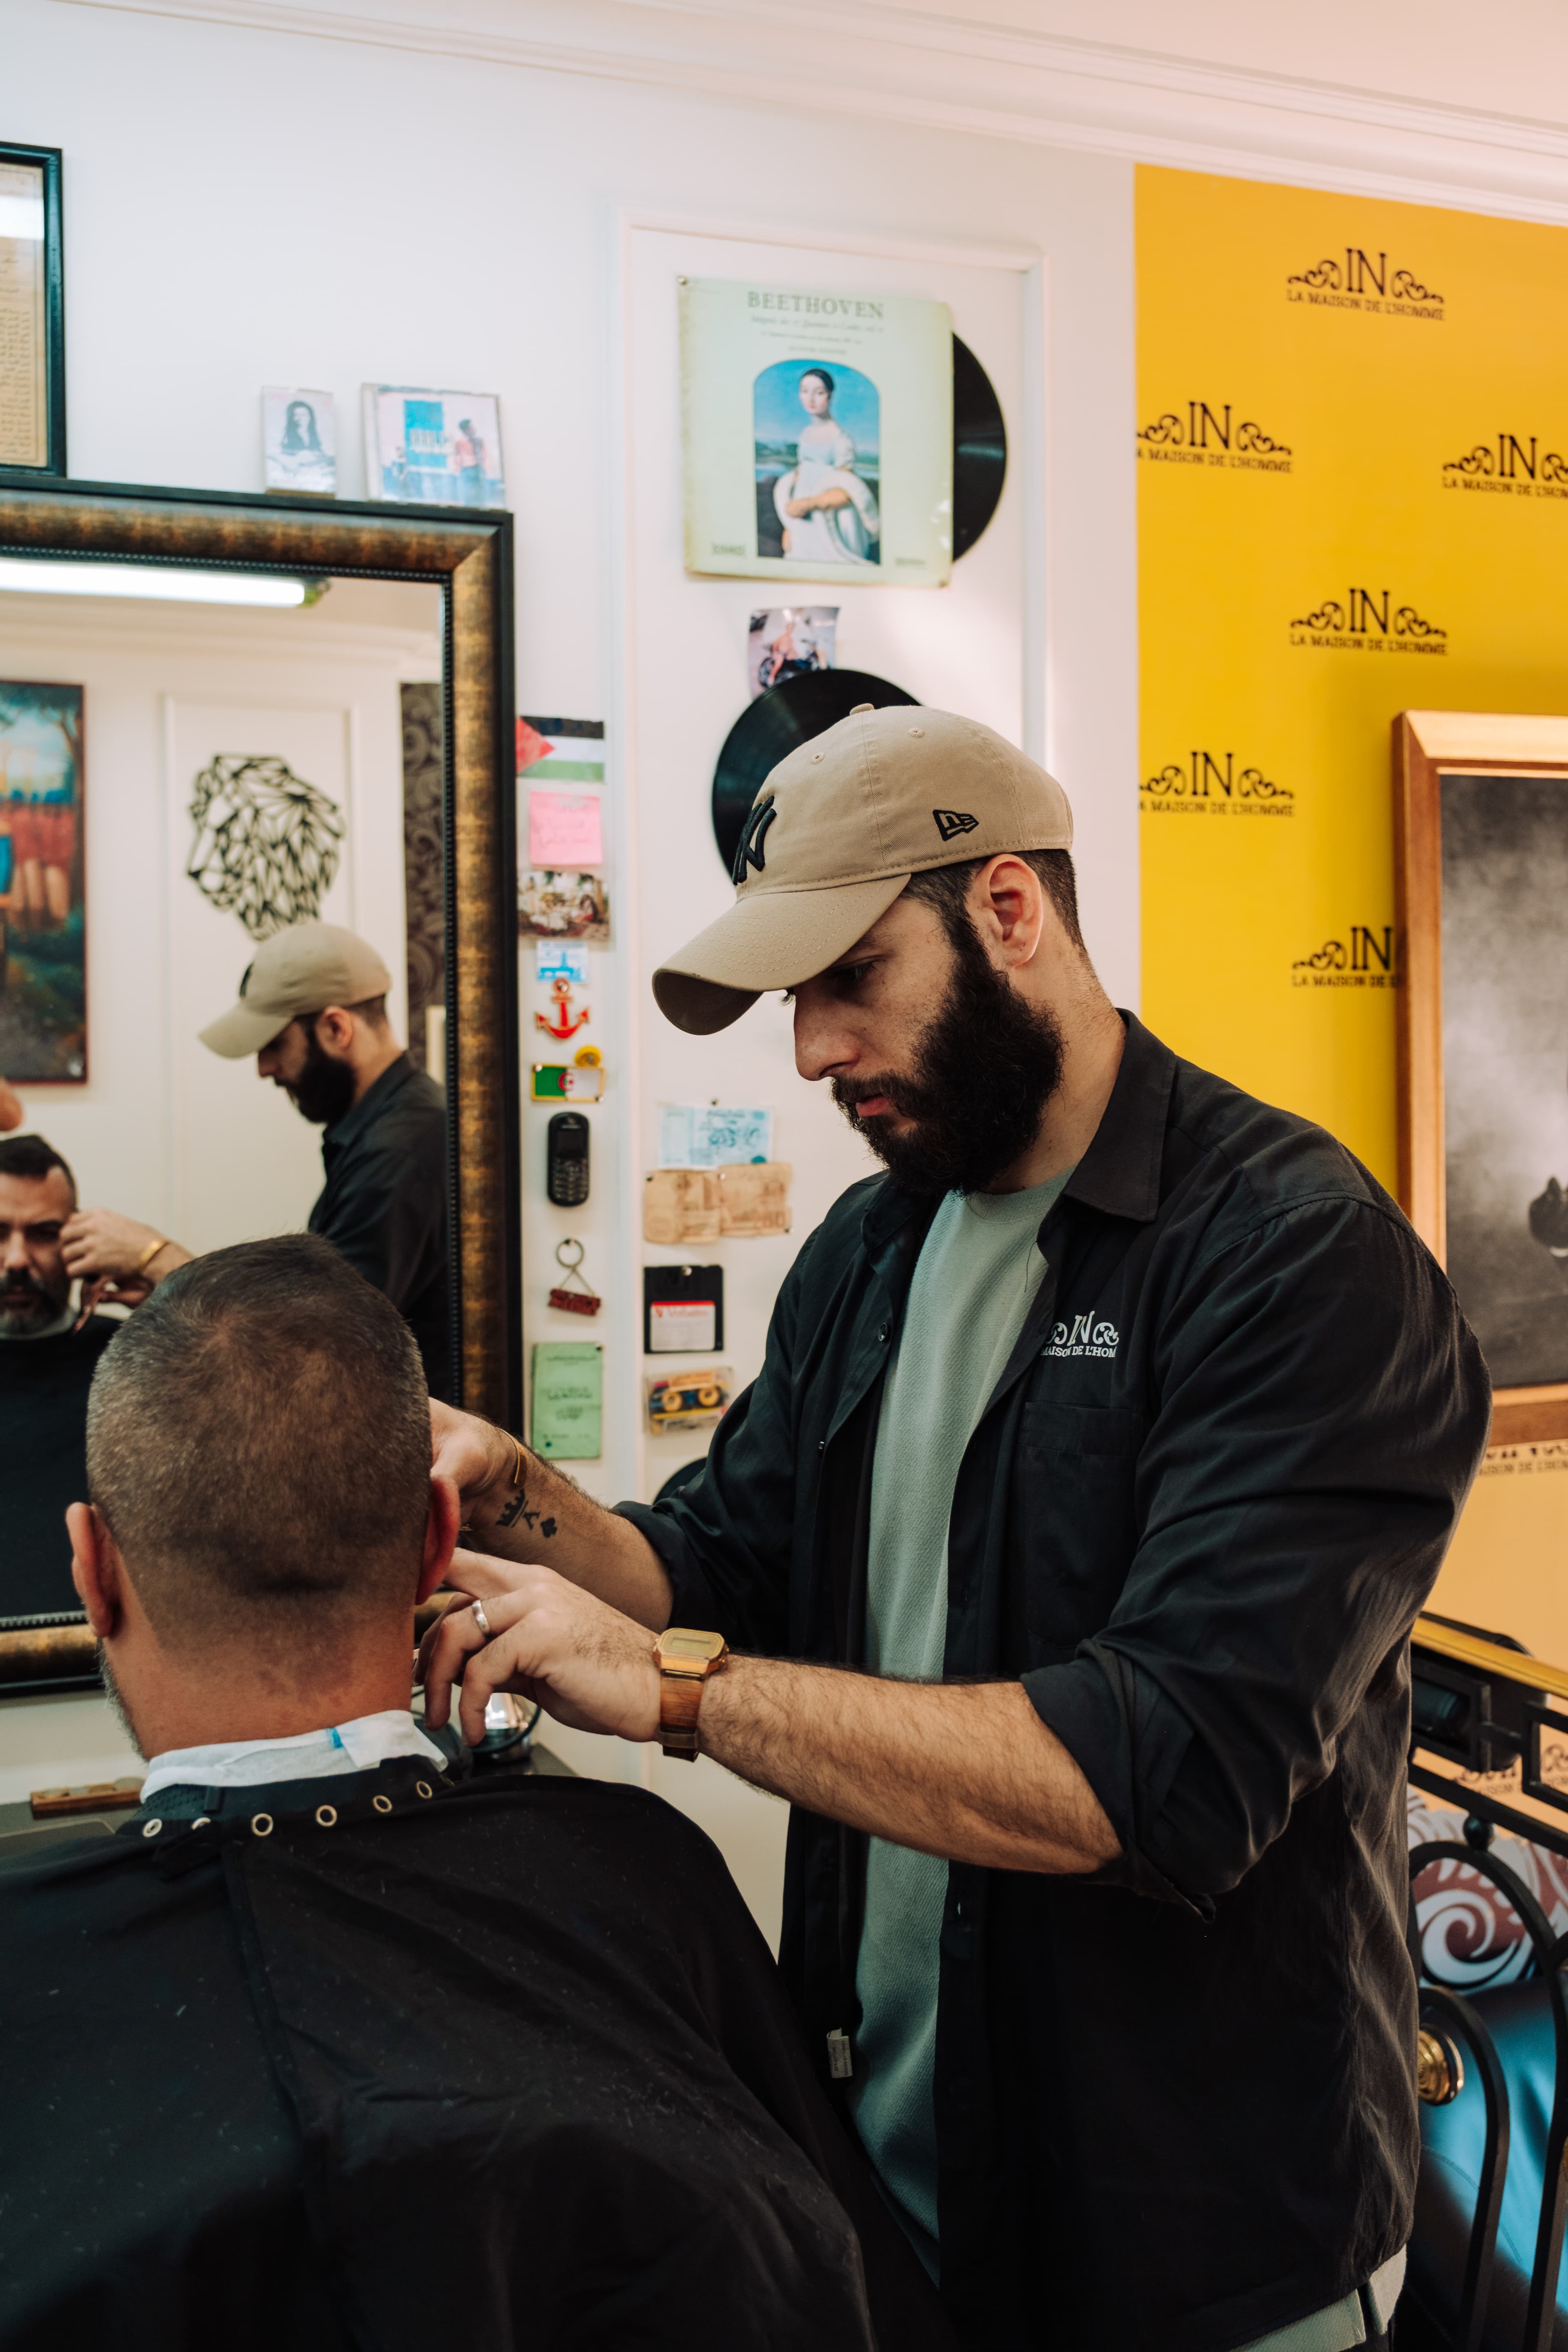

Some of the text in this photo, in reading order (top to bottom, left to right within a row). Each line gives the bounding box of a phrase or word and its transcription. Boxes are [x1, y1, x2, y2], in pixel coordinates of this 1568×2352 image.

[1346, 247, 1386, 296] IN
[747, 291, 884, 319] BEETHOVEN
[1287, 289, 1303, 302] LA
[1308, 293, 1360, 310] MAISON
[1365, 300, 1380, 313] DE
[1189, 401, 1231, 449] IN
[1149, 448, 1204, 465] MAISON
[1208, 454, 1227, 467] DE
[1499, 434, 1537, 479] IN
[1349, 588, 1390, 634] IN
[1290, 634, 1305, 646] LA
[1311, 635, 1363, 649] MAISON
[1368, 639, 1382, 651] DE
[1191, 751, 1233, 797] IN
[1351, 927, 1392, 971] IN
[1071, 1346, 1084, 1355] DE
